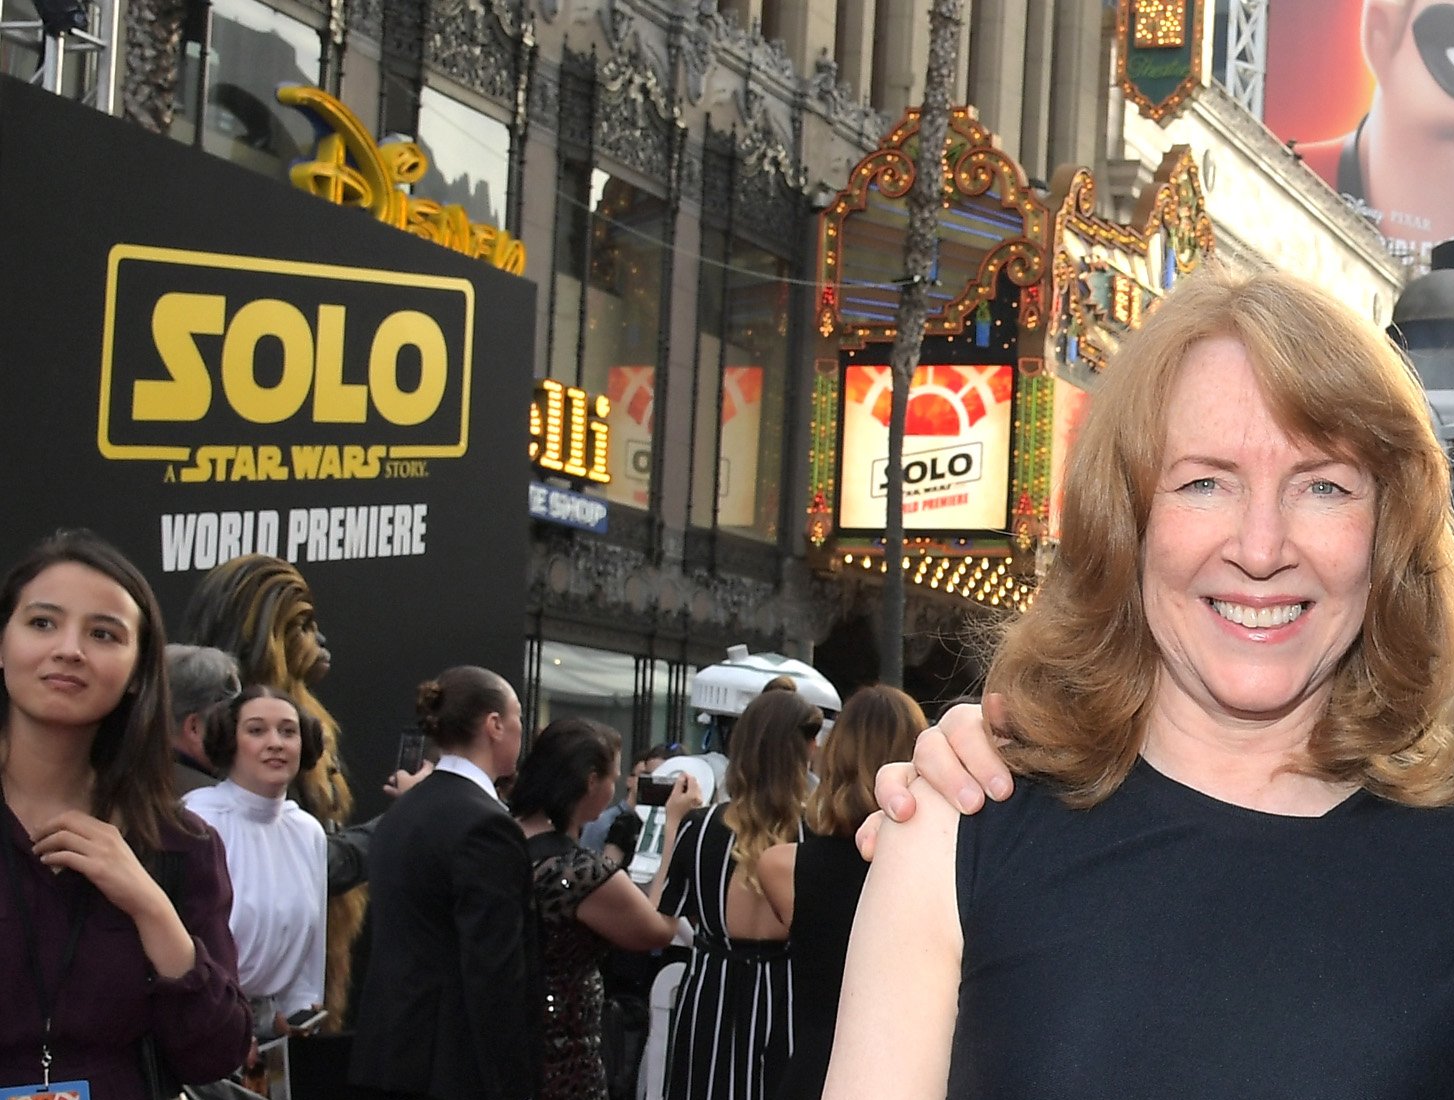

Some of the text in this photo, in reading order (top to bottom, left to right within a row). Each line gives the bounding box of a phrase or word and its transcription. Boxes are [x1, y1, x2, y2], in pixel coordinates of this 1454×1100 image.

[132, 291, 448, 426] SOLO
[163, 465, 176, 483] A
[180, 445, 289, 482] STAR
[291, 445, 387, 480] WARS
[880, 453, 973, 490] OLO
[161, 504, 428, 572] WORLD PREMIERE
